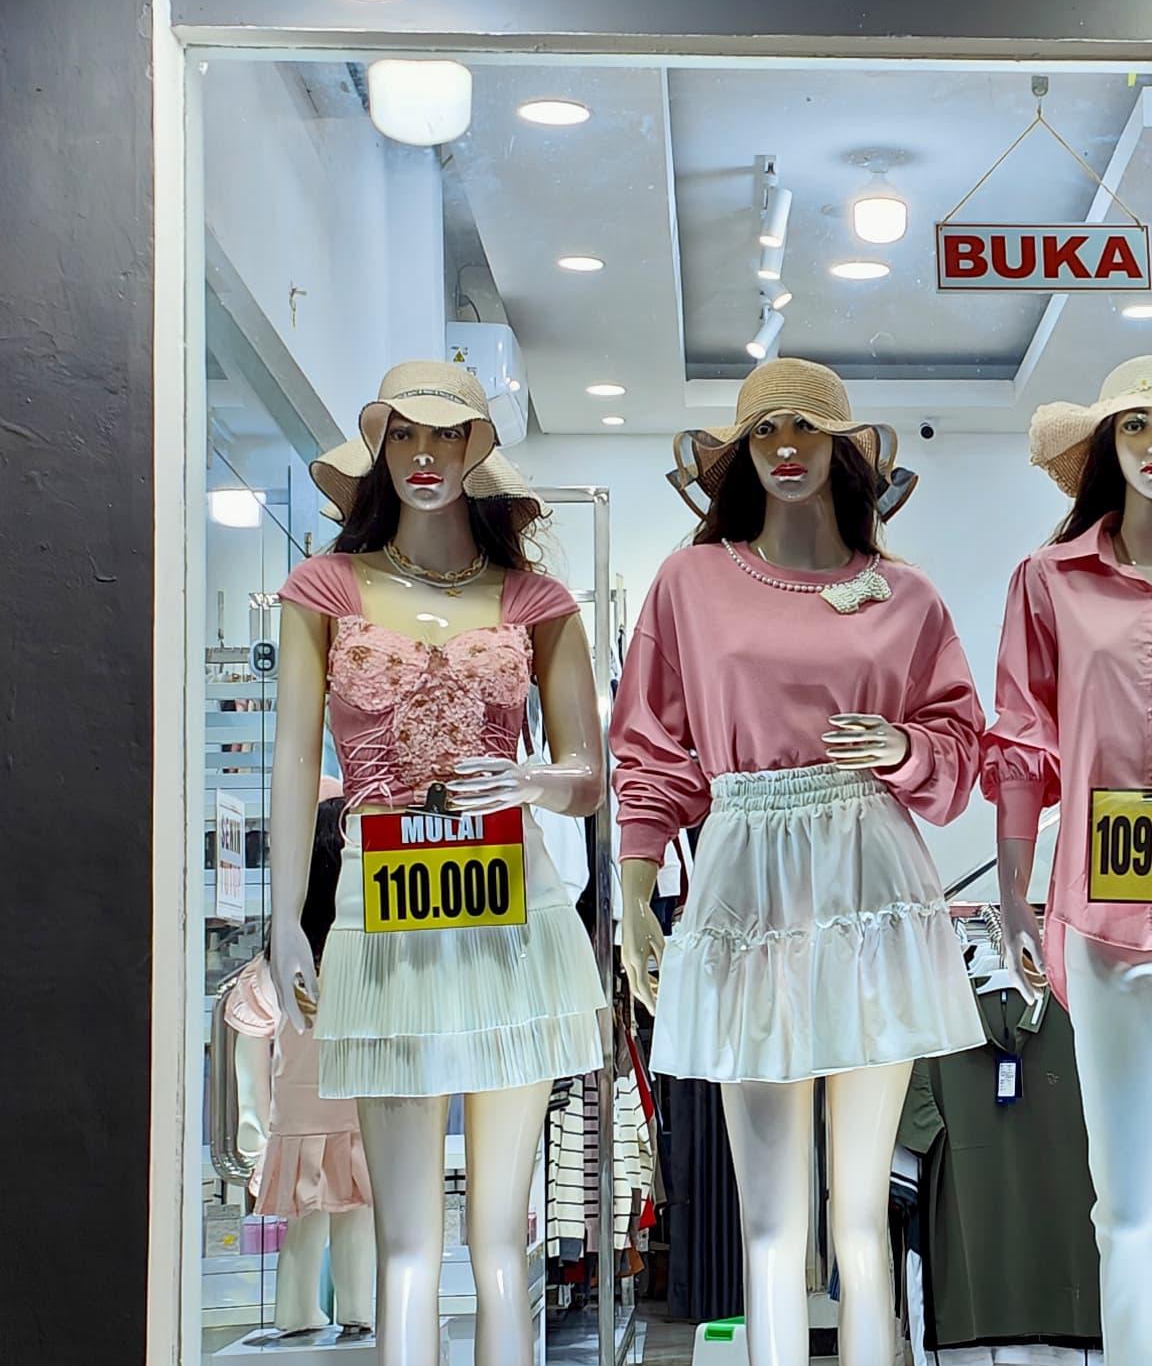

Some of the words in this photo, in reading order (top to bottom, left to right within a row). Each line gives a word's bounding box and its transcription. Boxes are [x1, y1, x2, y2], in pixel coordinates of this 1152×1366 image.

[943, 235, 1144, 280] BUKA
[400, 814, 484, 844] MULAI
[372, 857, 511, 922] 110.000
